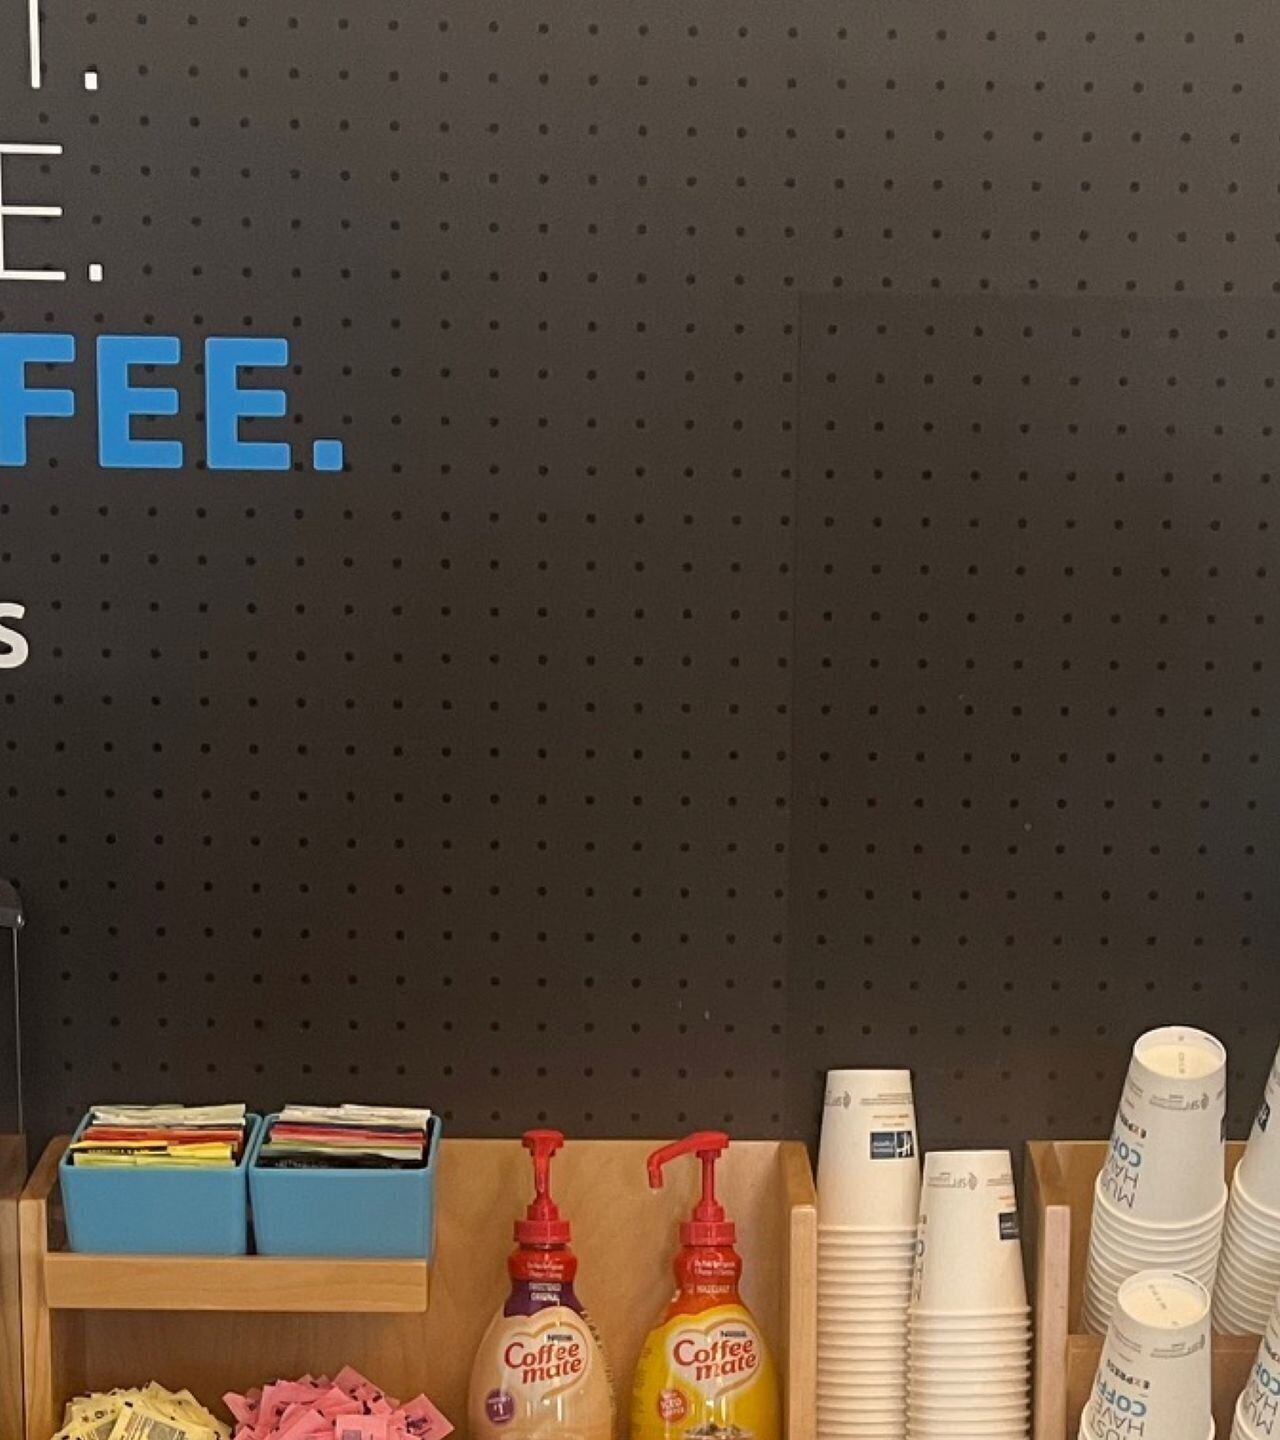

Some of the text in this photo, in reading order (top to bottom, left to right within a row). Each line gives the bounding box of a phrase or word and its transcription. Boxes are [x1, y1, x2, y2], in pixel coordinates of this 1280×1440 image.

[504, 1342, 579, 1369] Coffee
[673, 1339, 753, 1366] Coffee
[522, 1359, 581, 1384] mate
[696, 1353, 756, 1381] mate
